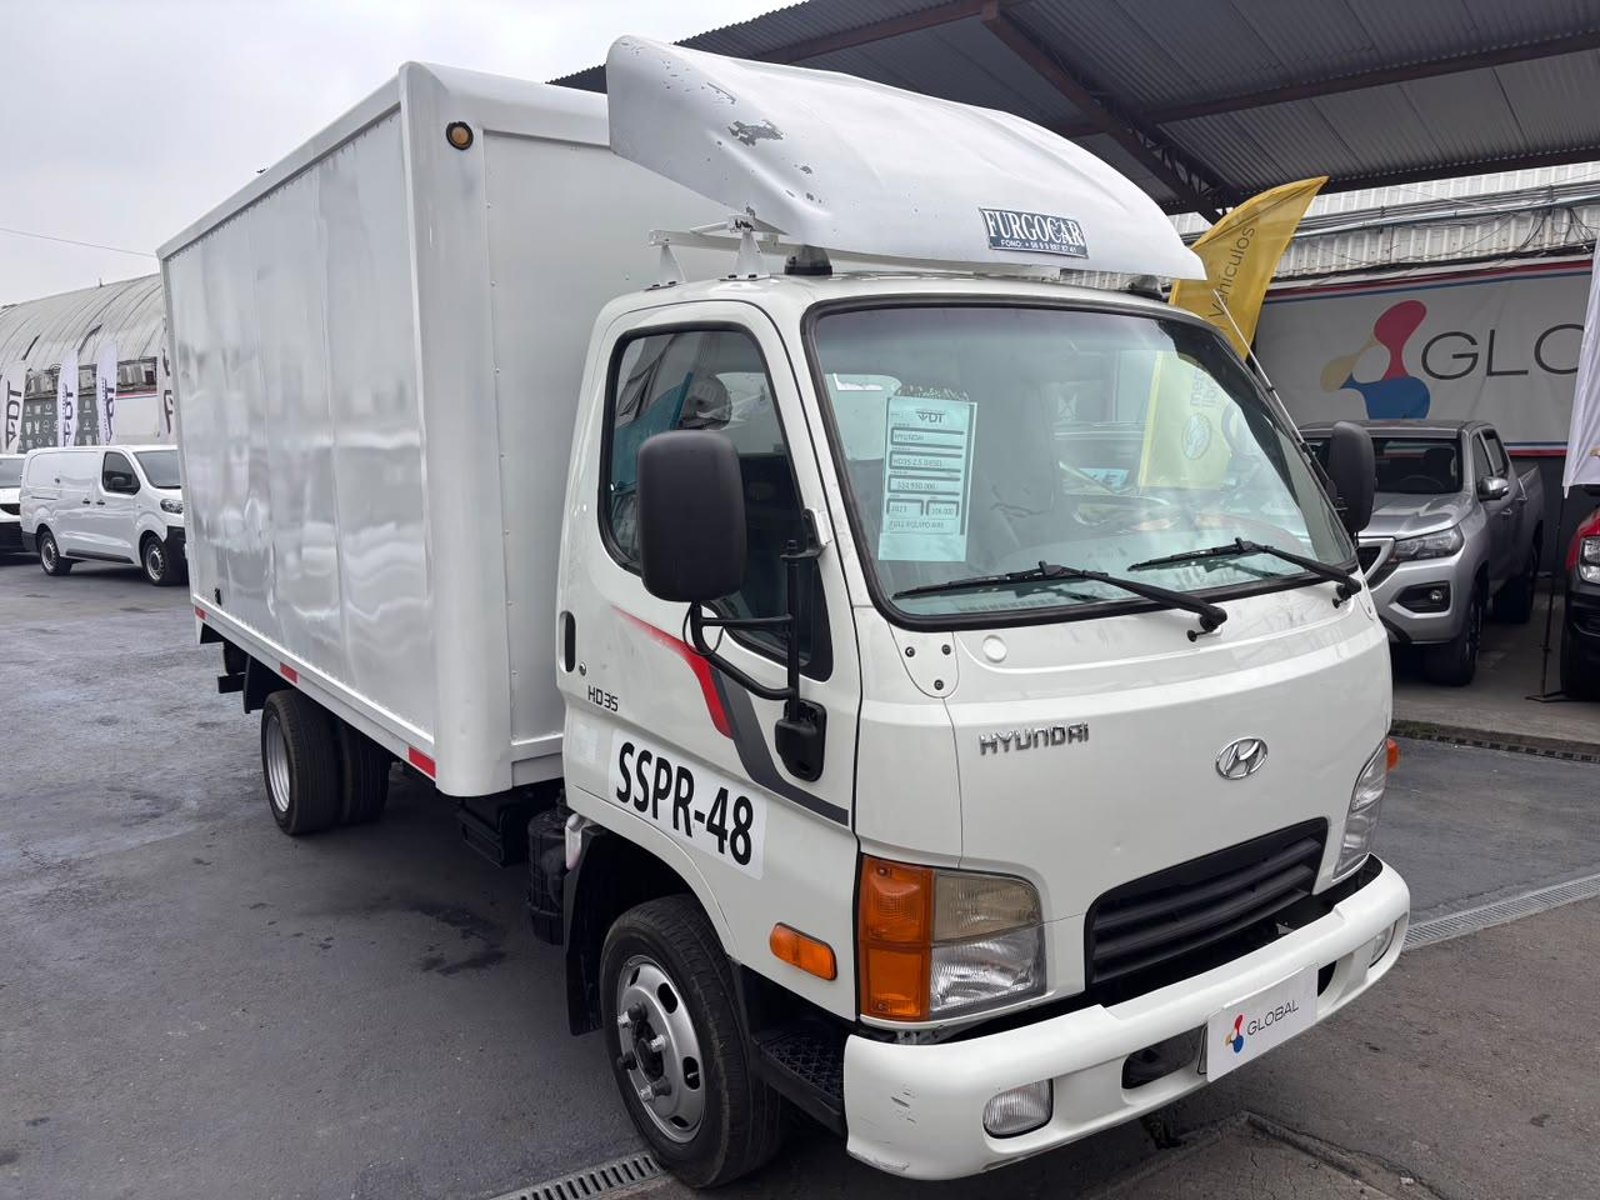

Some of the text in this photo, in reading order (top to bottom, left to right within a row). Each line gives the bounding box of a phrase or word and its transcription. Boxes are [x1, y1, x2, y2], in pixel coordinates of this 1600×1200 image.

[983, 211, 1085, 246] FURGOCAR
[588, 685, 619, 712] HD35
[980, 722, 1089, 756] HYUNDAI
[616, 742, 754, 865] SSPR-48
[1247, 1000, 1299, 1036] GLOBAL
